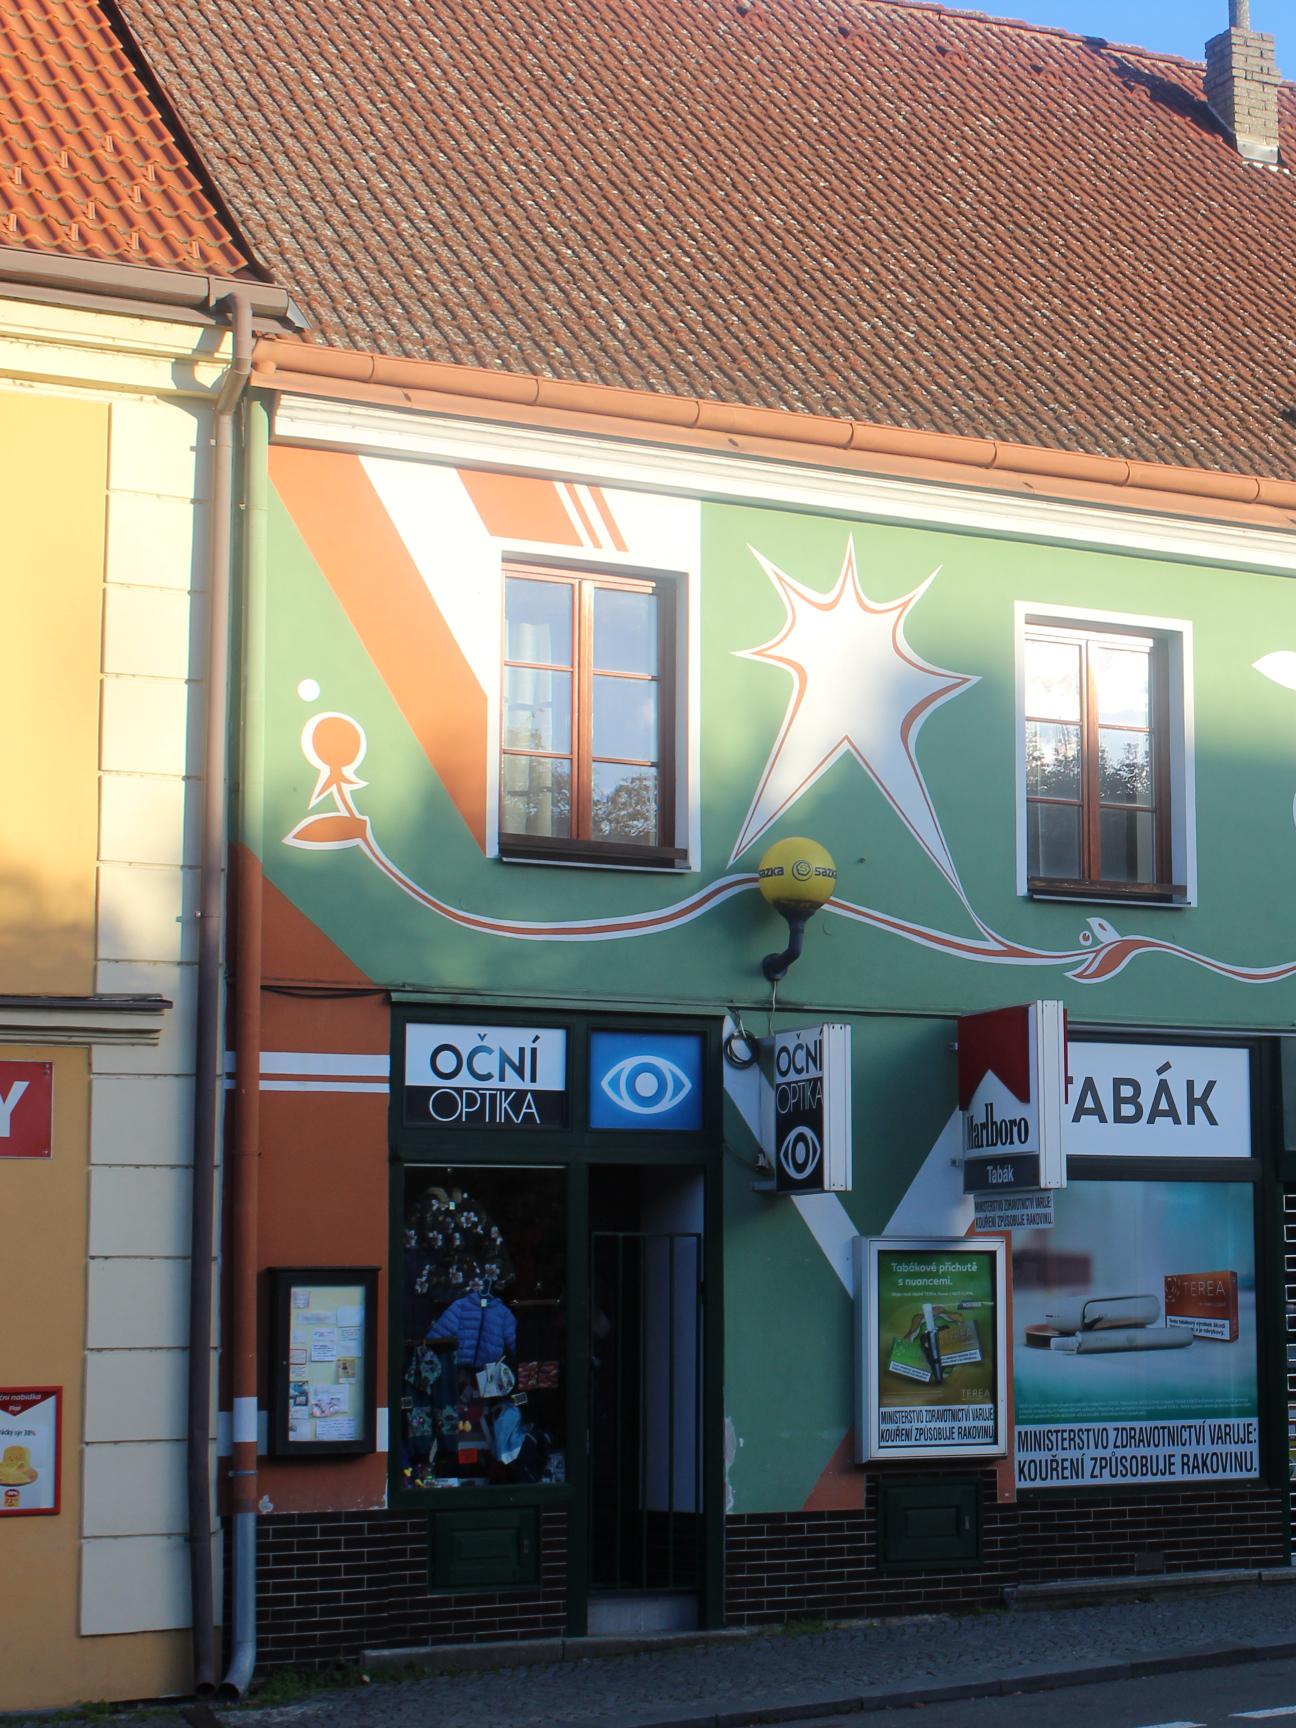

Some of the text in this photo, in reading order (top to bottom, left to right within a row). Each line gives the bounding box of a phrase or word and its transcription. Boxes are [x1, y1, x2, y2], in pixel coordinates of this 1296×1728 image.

[429, 1033, 541, 1084] OČNÍ
[776, 1027, 823, 1077] OČNÍ
[429, 1088, 541, 1124] OPTIKA
[776, 1080, 824, 1114] OPTIKA
[1067, 1060, 1219, 1126] ABÁK
[966, 1102, 1030, 1150] Marlboro
[987, 1163, 1014, 1184] Tabák
[891, 1261, 978, 1274] Tabákové příchutě
[905, 1276, 953, 1286] nuancemi.
[1183, 1280, 1226, 1297] TEREA
[961, 1389, 990, 1398] TEREA
[880, 1409, 923, 1425] MINISTERSTVO
[925, 1405, 970, 1424] ZDRAVOTNICTVÍ
[881, 1425, 913, 1443] KOUŘENÍ
[914, 1424, 955, 1441] ZPŮSOBUJE
[1017, 1420, 1257, 1453] MINISTERSTVO ZDRAVOTNICTVÍ VARUJE:
[1018, 1451, 1257, 1482] KOUŘENÍ ZPŮSOBUJE RAKOVINU.
